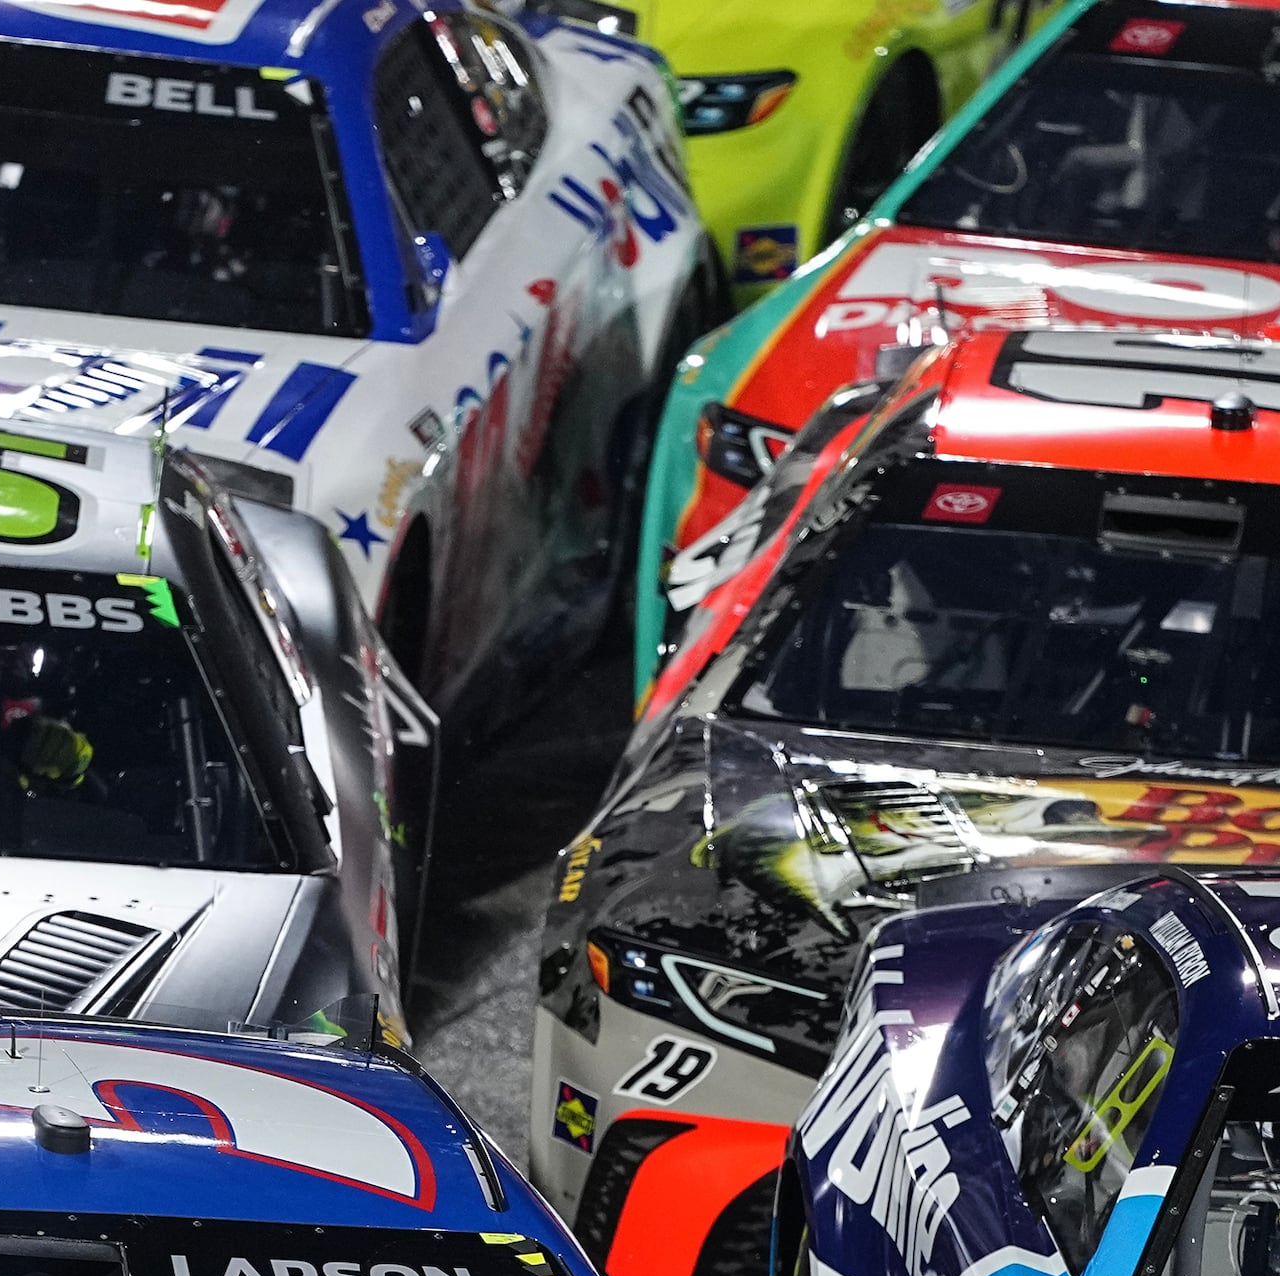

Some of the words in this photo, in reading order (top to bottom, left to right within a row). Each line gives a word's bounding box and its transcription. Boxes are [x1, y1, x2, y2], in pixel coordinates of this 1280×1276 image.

[105, 72, 278, 121] BELL
[1149, 911, 1194, 956] WILLIAM
[1170, 941, 1211, 989] BYRON
[616, 1038, 715, 1103] 19
